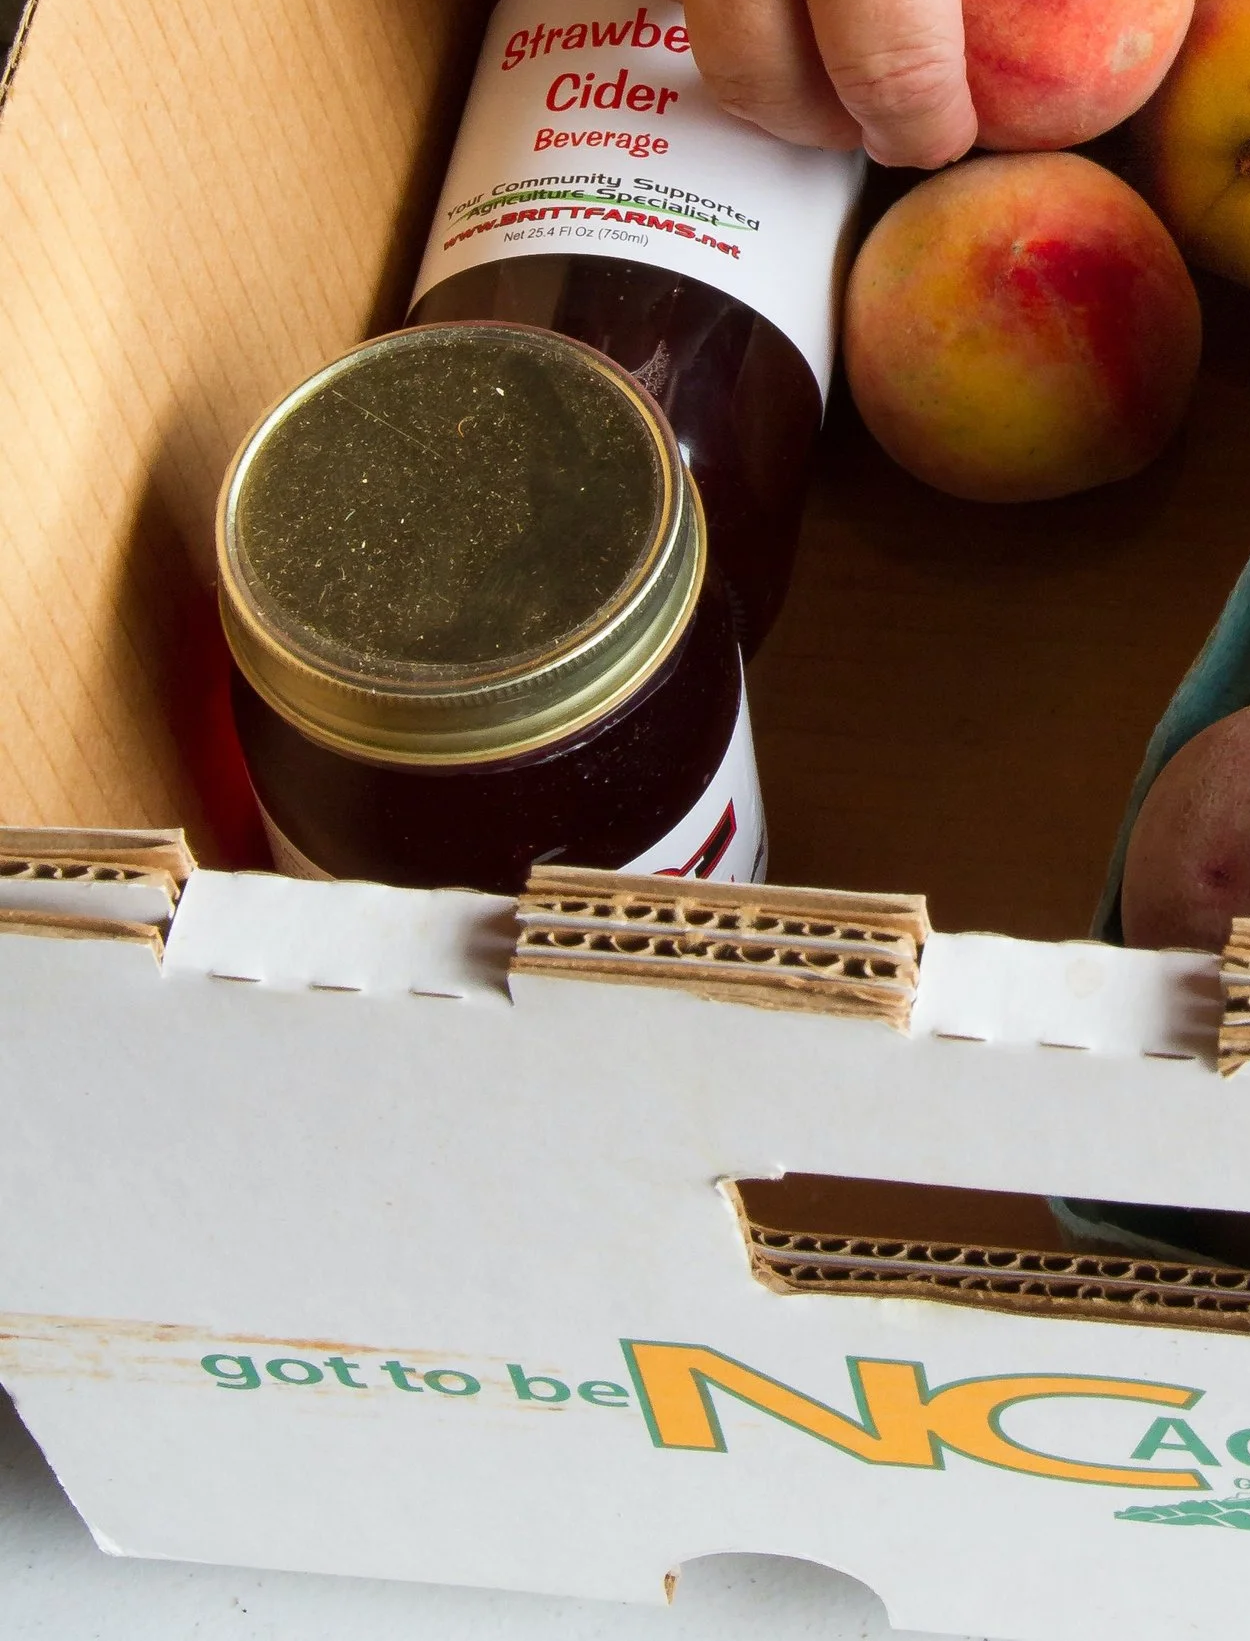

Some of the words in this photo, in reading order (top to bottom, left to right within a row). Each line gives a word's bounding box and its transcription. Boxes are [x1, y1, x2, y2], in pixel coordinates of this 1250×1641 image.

[501, 8, 690, 71] Strawbe
[546, 69, 679, 115] Cider
[533, 128, 669, 158] Beverage
[447, 193, 484, 220] Your
[491, 173, 621, 196] Community
[633, 177, 760, 231] Supported
[466, 189, 584, 220] Agriculture
[595, 188, 719, 226] Specialist
[443, 206, 741, 259] www.BRITTFARMS.net
[503, 229, 525, 242] Net
[527, 226, 555, 239] 25.4
[575, 226, 594, 237] Oz
[597, 227, 649, 247] (750ml)
[202, 1352, 359, 1391] got
[377, 1360, 481, 1397] to
[514, 1363, 631, 1408] be
[620, 1338, 1213, 1490] NC
